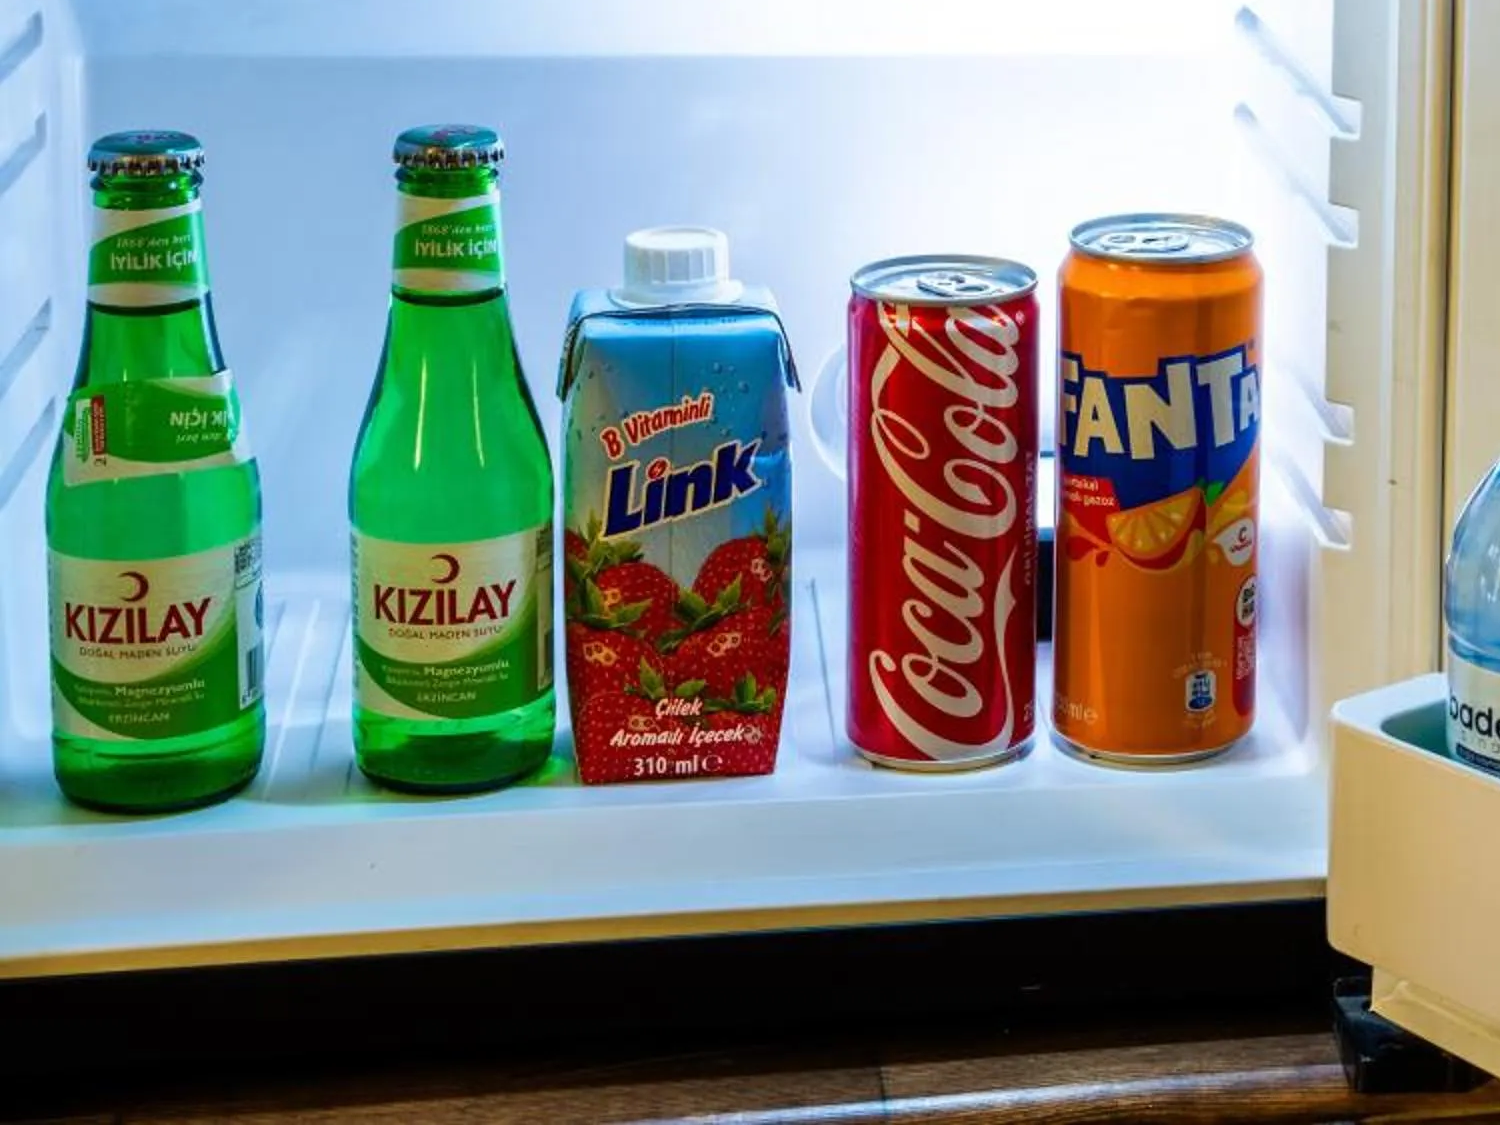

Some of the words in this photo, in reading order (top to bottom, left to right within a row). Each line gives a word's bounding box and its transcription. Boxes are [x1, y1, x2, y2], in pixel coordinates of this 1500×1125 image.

[602, 428, 624, 459] B
[622, 393, 714, 444] Vitaminli
[1060, 349, 1260, 460] FANTA
[604, 440, 762, 536] Link
[65, 597, 212, 644] KIZILAY
[373, 579, 517, 626] KIZILAY
[655, 698, 703, 717] Çilek
[632, 756, 667, 776] 310
[674, 754, 699, 774] ml
